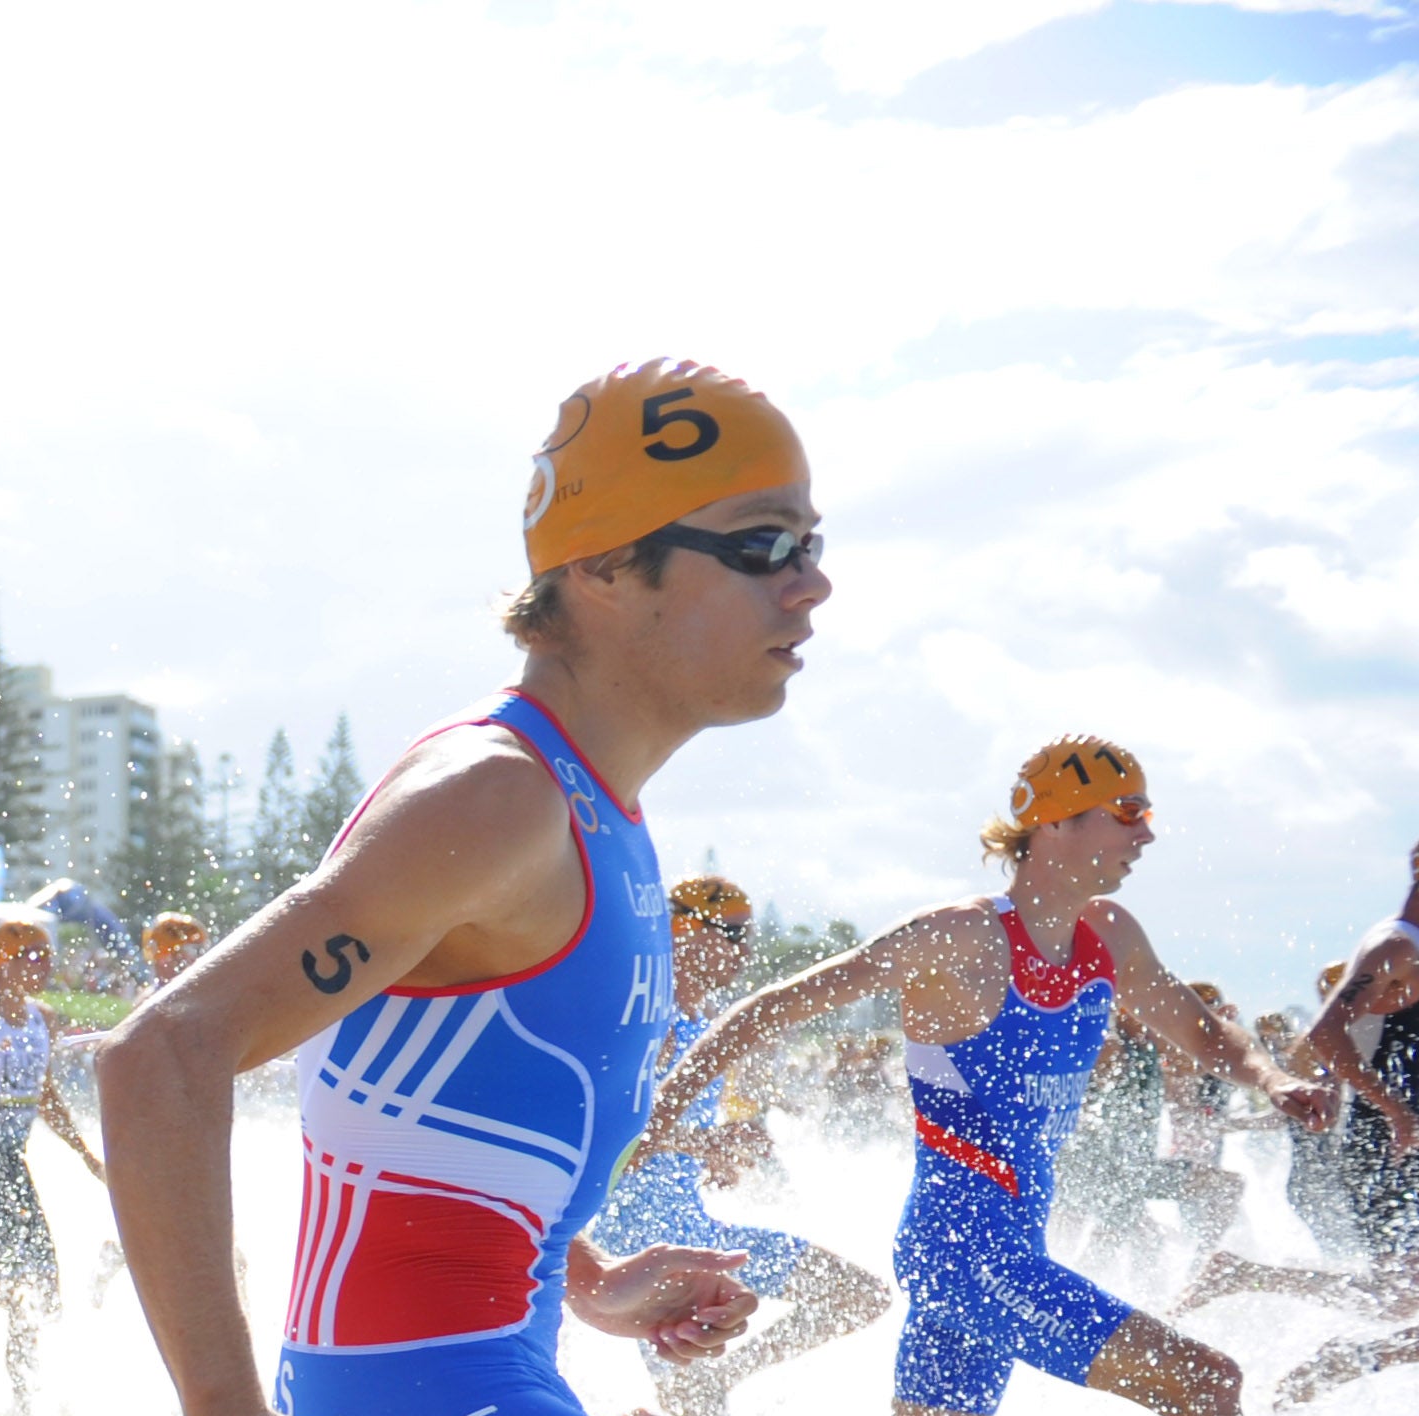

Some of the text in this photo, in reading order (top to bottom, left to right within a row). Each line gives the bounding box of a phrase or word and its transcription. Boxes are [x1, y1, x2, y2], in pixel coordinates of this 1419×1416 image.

[642, 387, 720, 461] 5
[555, 479, 583, 504] ITU
[1061, 747, 1127, 785] 11
[301, 934, 370, 994] 5
